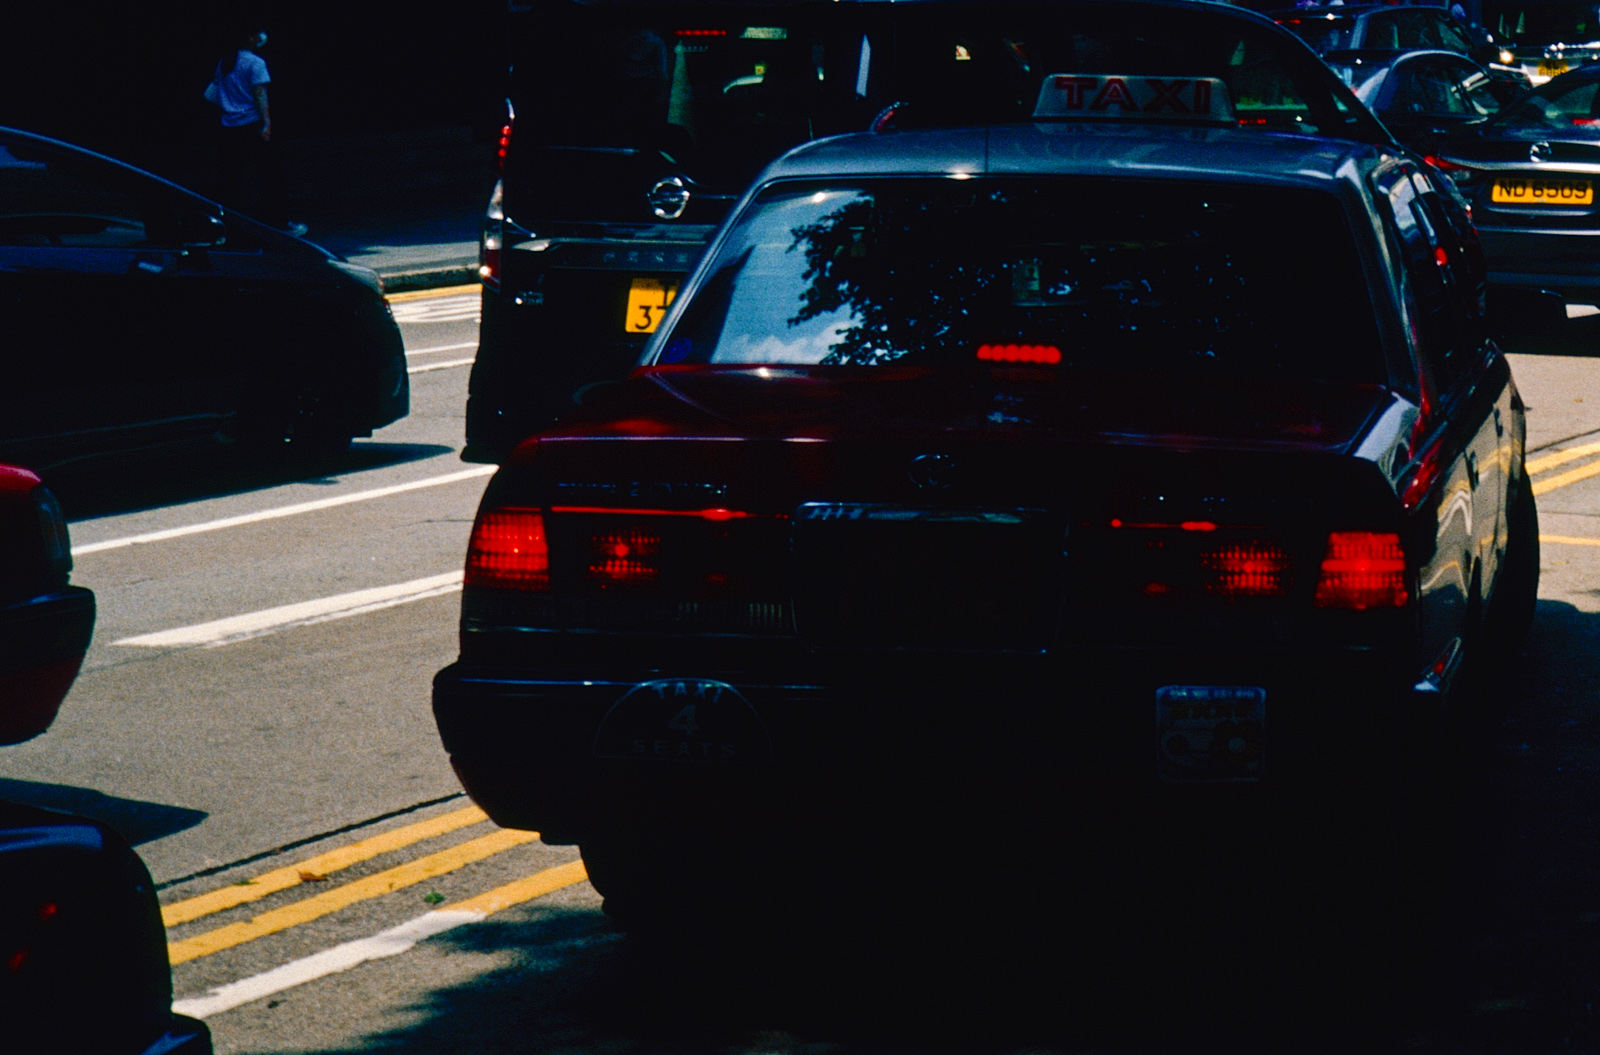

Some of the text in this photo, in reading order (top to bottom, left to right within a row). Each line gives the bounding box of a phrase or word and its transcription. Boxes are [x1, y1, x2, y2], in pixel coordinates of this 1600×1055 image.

[1055, 77, 1212, 114] TAXI
[668, 704, 699, 736] 4
[632, 738, 736, 758] SEATS
